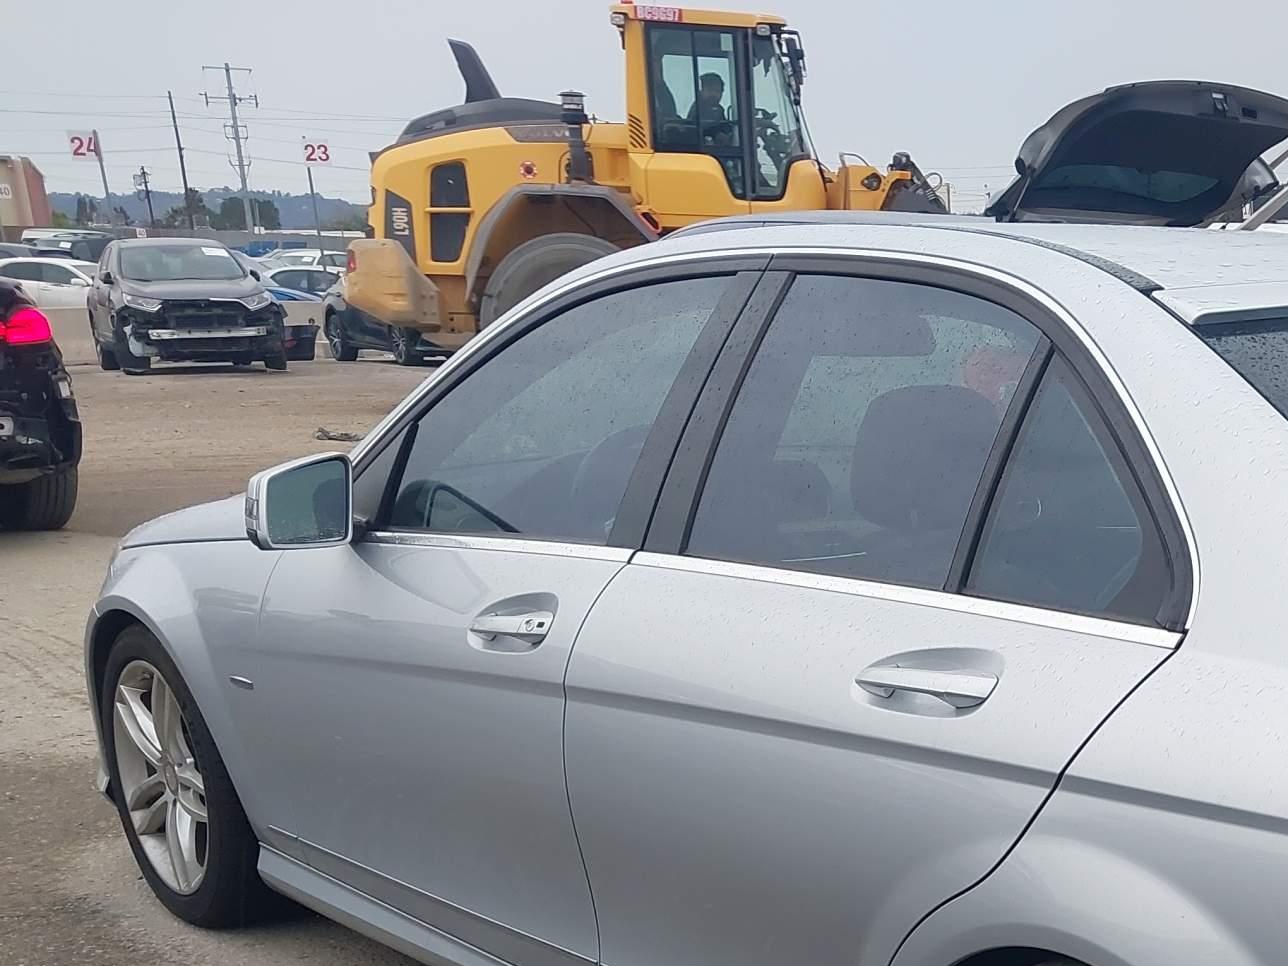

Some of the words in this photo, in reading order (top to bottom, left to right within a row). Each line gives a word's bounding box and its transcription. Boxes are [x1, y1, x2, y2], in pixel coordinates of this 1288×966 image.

[70, 136, 99, 156] 24
[303, 144, 330, 161] 23
[391, 207, 409, 236] L90H
